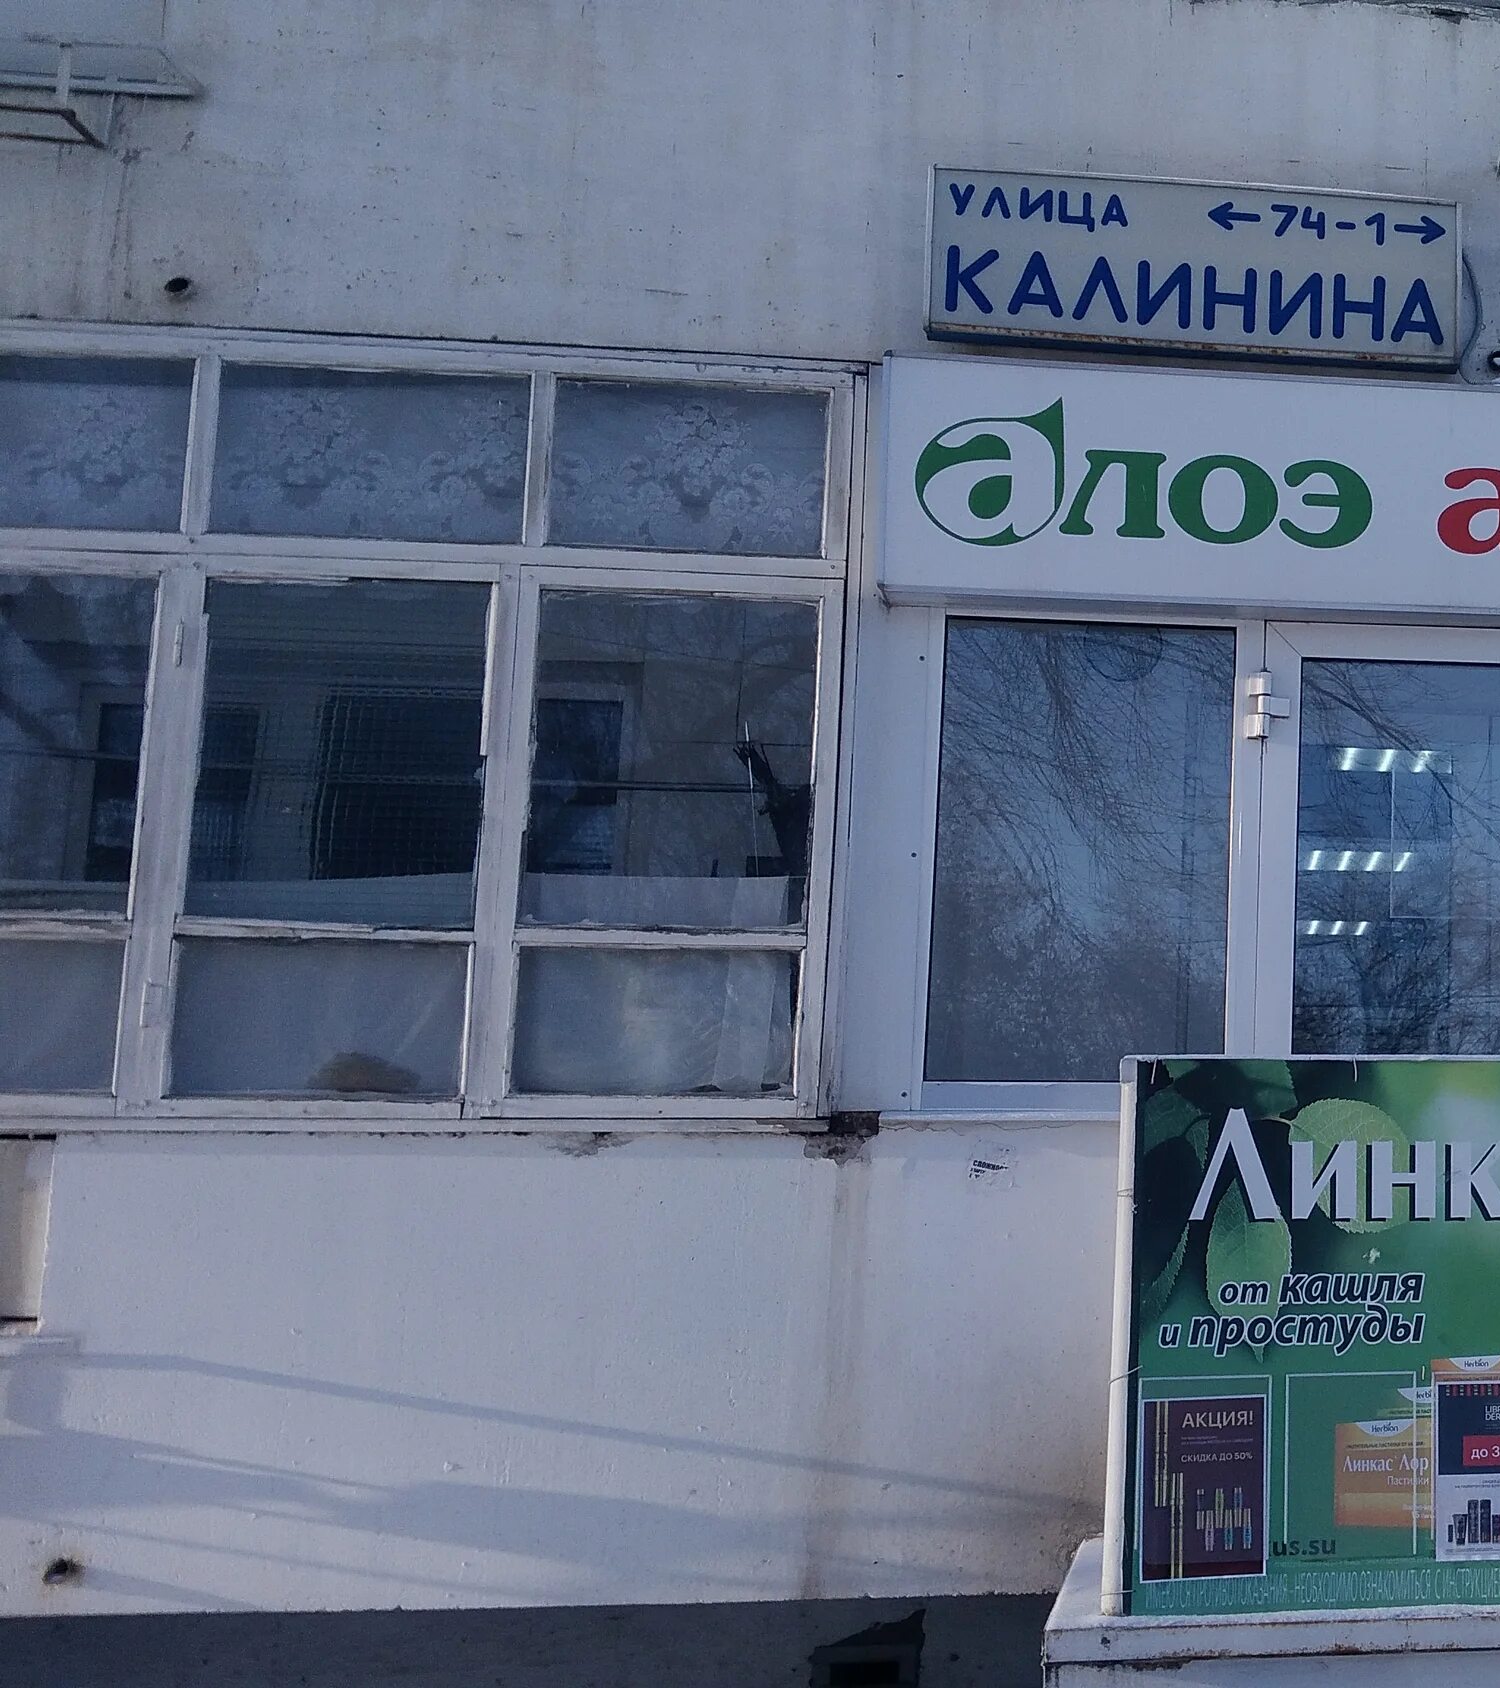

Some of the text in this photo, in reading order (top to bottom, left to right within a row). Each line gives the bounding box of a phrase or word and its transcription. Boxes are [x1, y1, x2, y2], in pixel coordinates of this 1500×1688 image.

[949, 183, 1129, 232] УЛИЦА
[1271, 203, 1385, 246] 74-1
[944, 244, 1444, 345] КАЛИНИНА
[1218, 1272, 1426, 1306] от кашля
[1158, 1302, 1426, 1357] и простуды
[1464, 1360, 1489, 1368] Herbion
[1181, 1410, 1254, 1429] АКЦИЯ!
[1371, 1423, 1399, 1433] Herbion
[1181, 1453, 1218, 1462] СКИДКА
[1219, 1452, 1233, 1461] ДО
[1470, 1448, 1489, 1460] до
[1342, 1455, 1393, 1473] Линкас
[1269, 1539, 1336, 1556] us.su
